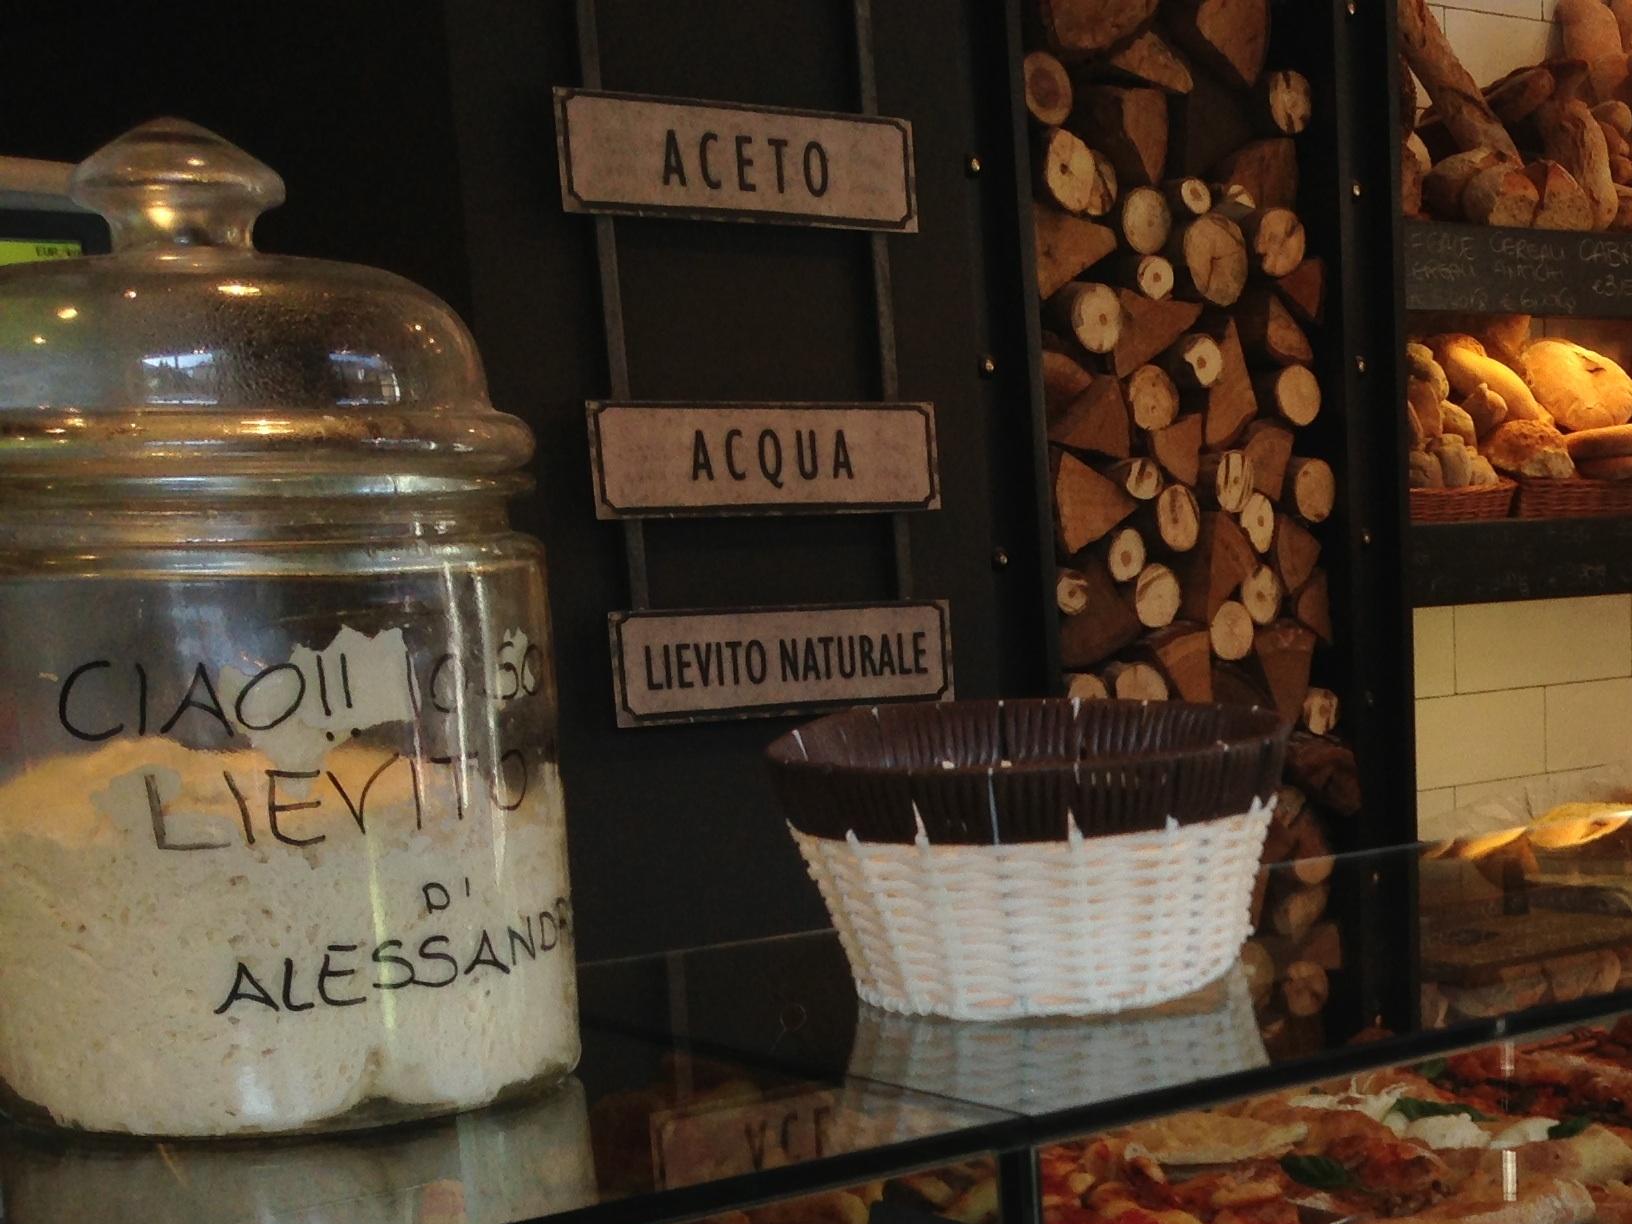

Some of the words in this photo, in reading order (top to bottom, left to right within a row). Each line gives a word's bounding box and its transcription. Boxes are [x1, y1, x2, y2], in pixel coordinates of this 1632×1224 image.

[661, 128, 829, 198] ACETO
[690, 427, 855, 490] ACQUA
[643, 639, 768, 691] LIEVITO
[778, 631, 929, 683] NATURALE
[144, 749, 528, 851] LIEVITO
